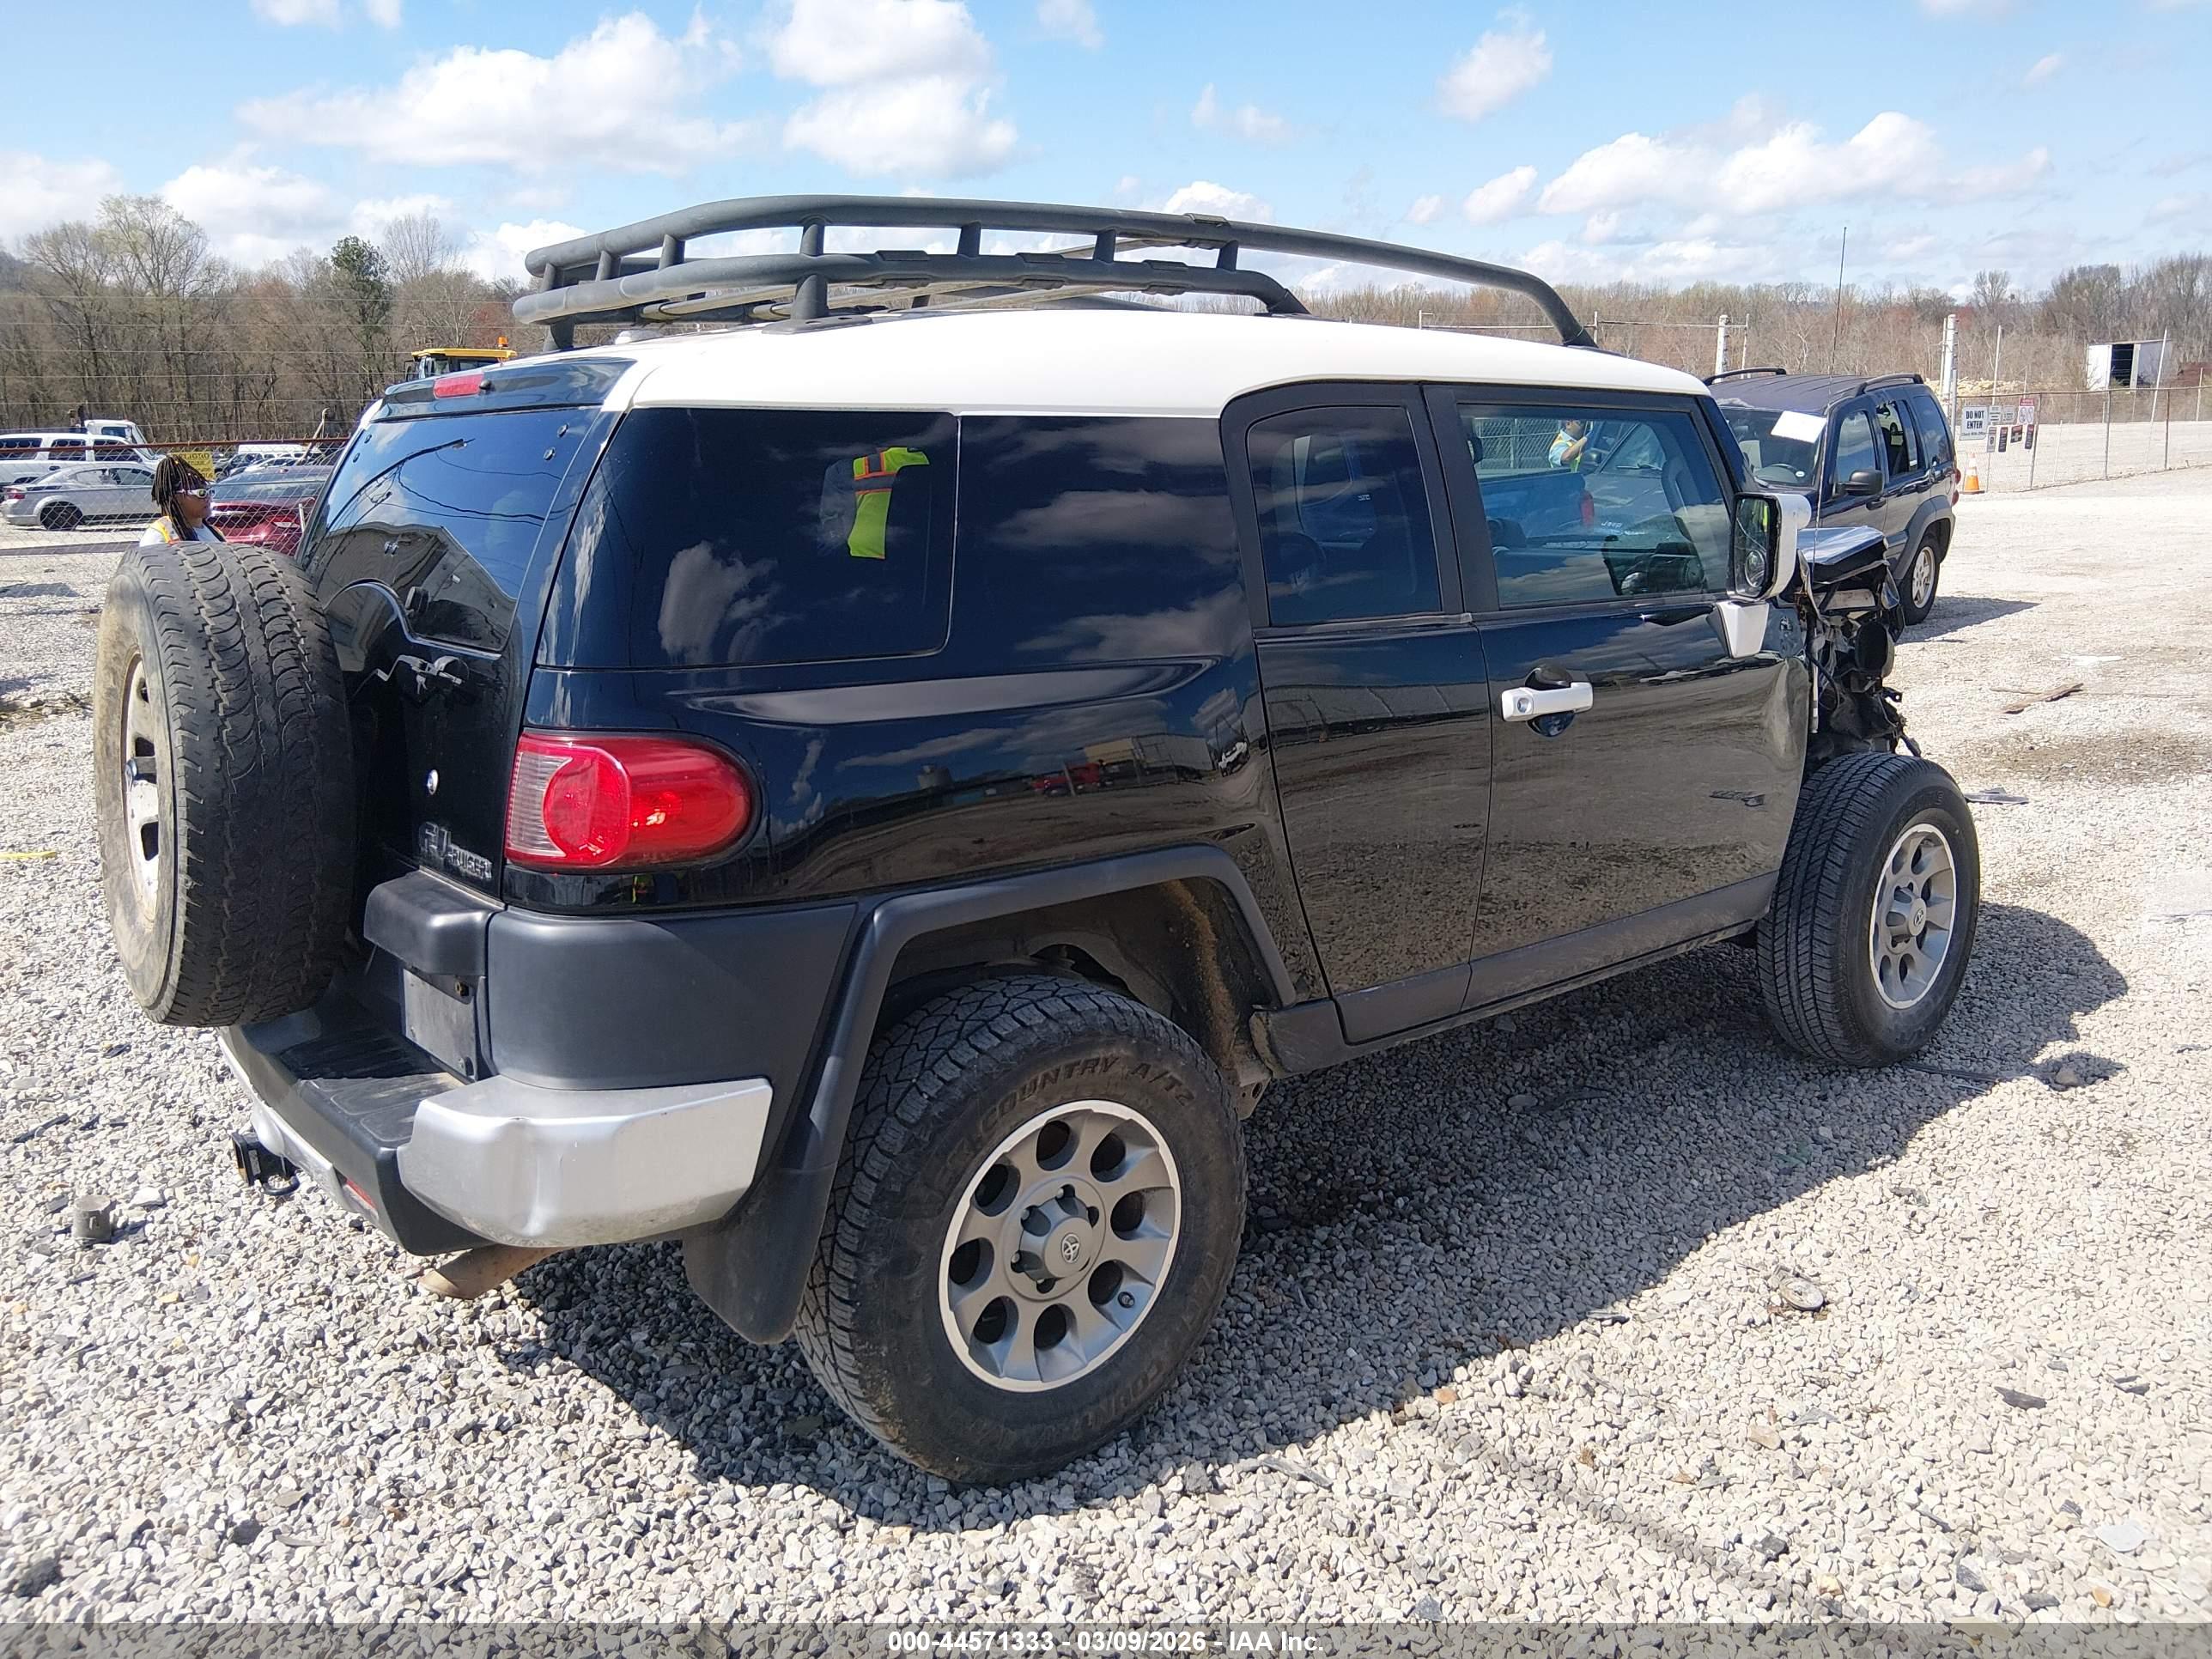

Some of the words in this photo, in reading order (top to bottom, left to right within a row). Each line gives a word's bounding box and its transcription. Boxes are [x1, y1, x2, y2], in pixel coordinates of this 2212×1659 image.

[1966, 410, 1973, 420] DO
[1974, 410, 1985, 419] NOT
[1966, 420, 1984, 429] ENTER
[444, 843, 493, 880] CRUISER
[980, 1056, 1119, 1132] COUNTRY
